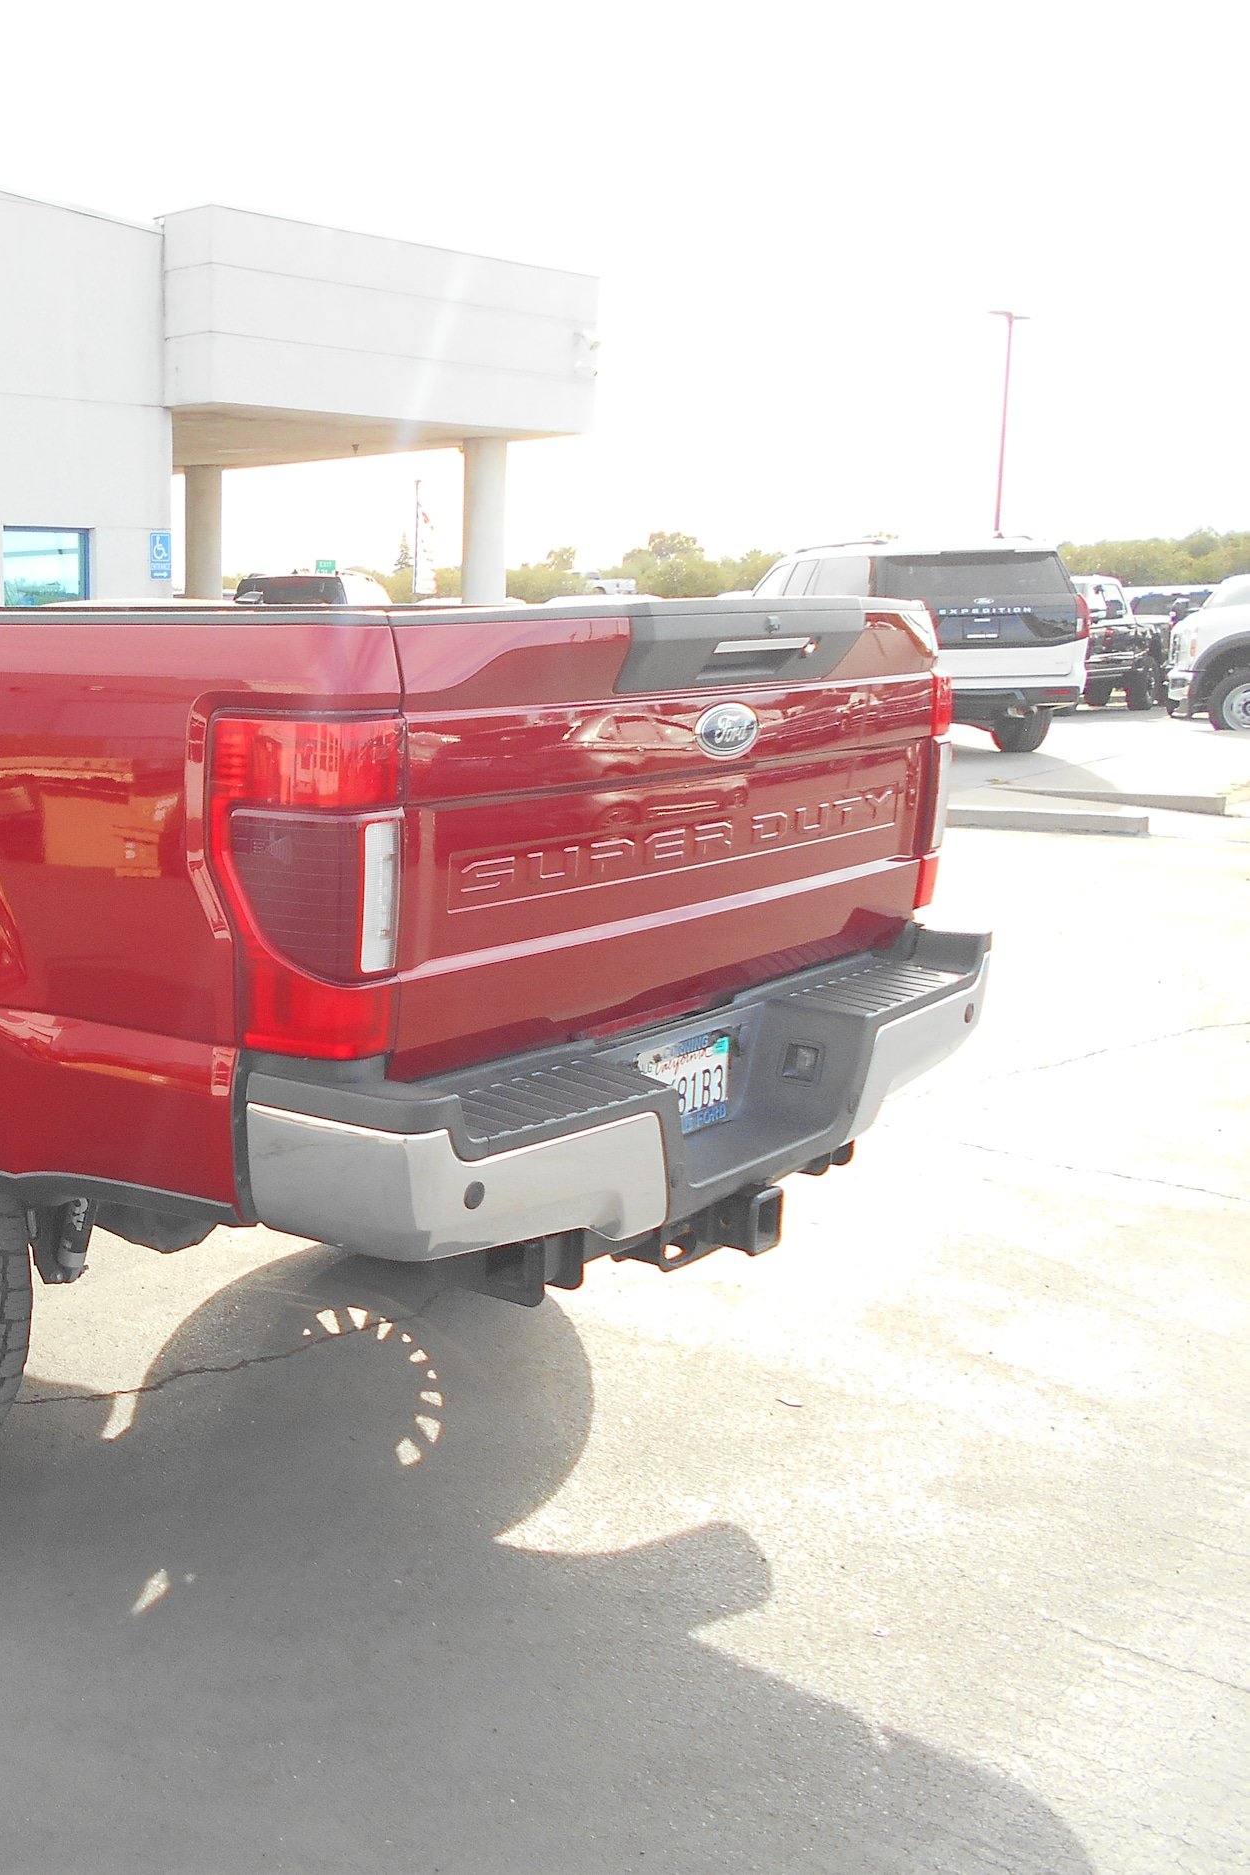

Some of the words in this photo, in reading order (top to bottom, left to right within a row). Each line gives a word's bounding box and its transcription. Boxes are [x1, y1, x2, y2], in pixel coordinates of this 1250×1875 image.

[939, 607, 1032, 615] EXPEDITION
[714, 714, 755, 744] Ford
[461, 819, 733, 893] SUPER
[751, 790, 894, 844] DUTY
